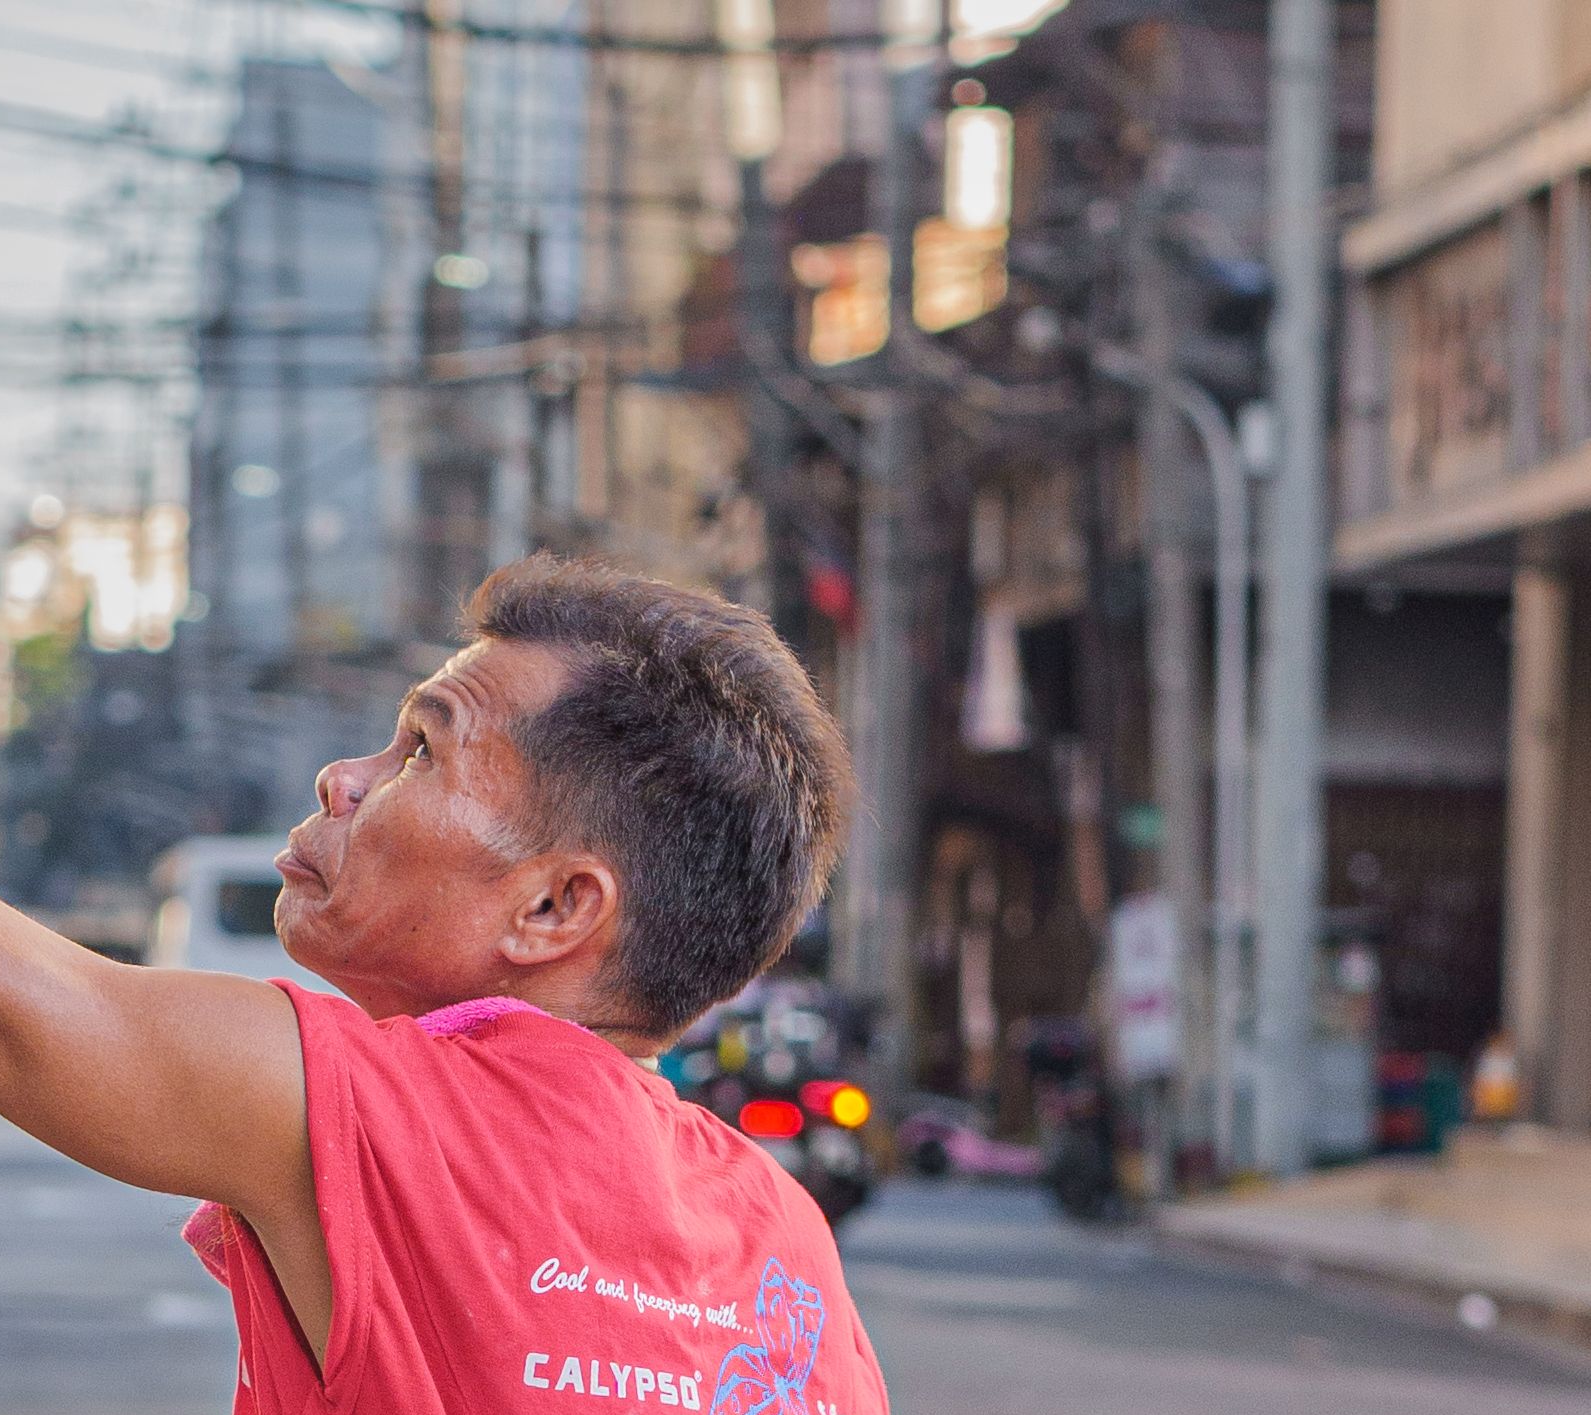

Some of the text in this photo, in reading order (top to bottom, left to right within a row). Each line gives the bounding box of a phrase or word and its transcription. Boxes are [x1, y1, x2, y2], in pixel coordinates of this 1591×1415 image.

[530, 1257, 589, 1294] Cool
[595, 1278, 628, 1302] and
[633, 1283, 701, 1328] freezing
